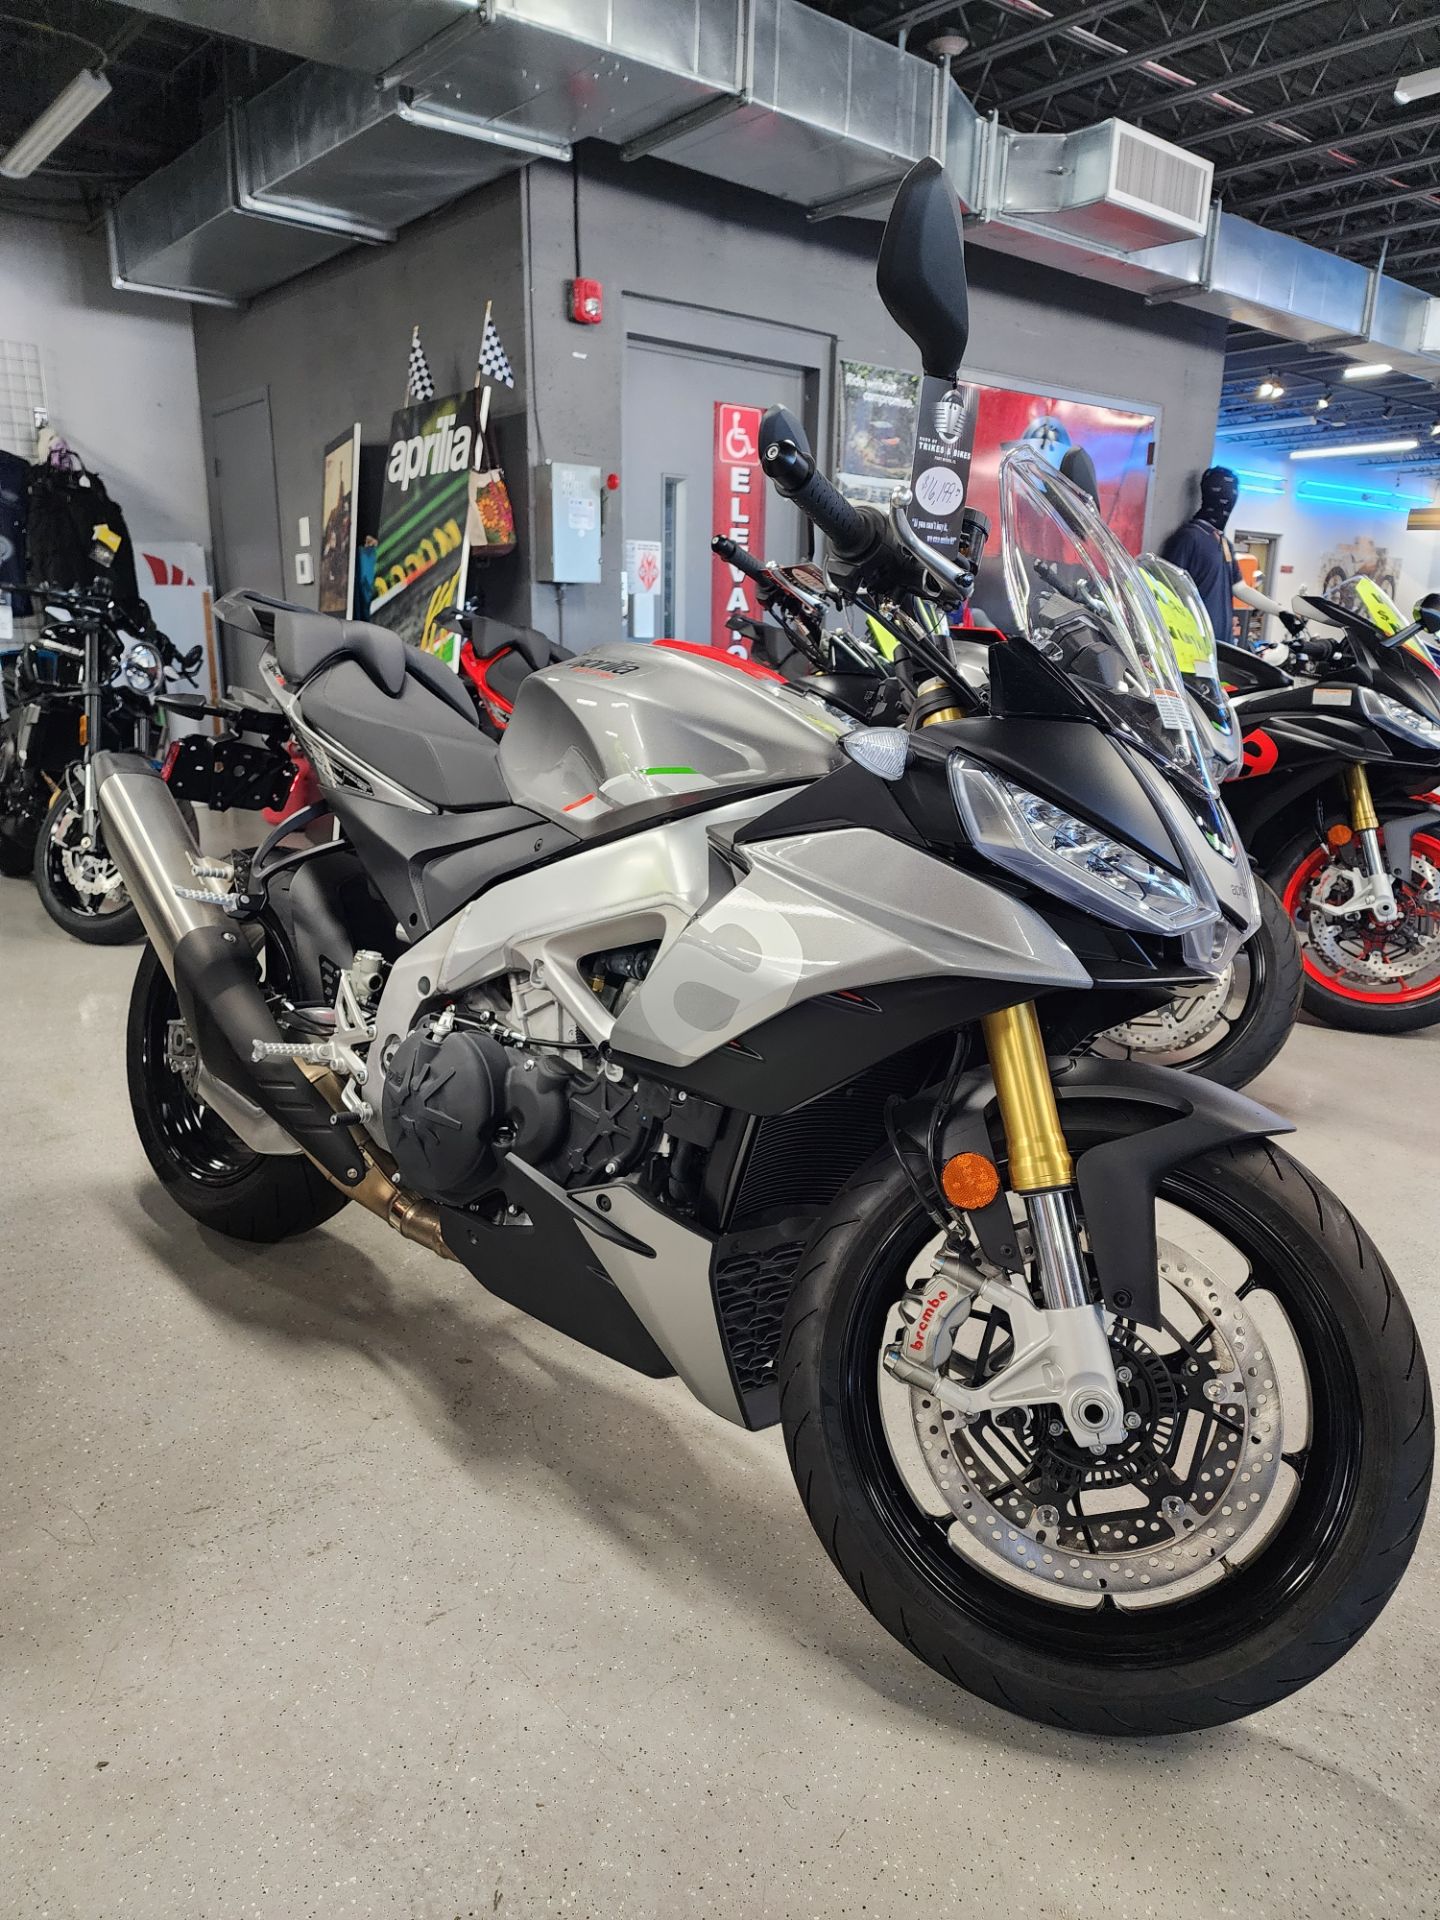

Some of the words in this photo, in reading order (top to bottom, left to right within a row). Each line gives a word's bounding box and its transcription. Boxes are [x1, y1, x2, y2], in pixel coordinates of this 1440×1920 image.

[387, 413, 473, 492] aprilia
[918, 441, 945, 455] TRIKES
[953, 449, 972, 460] BIKES
[909, 1289, 949, 1352] brembo
